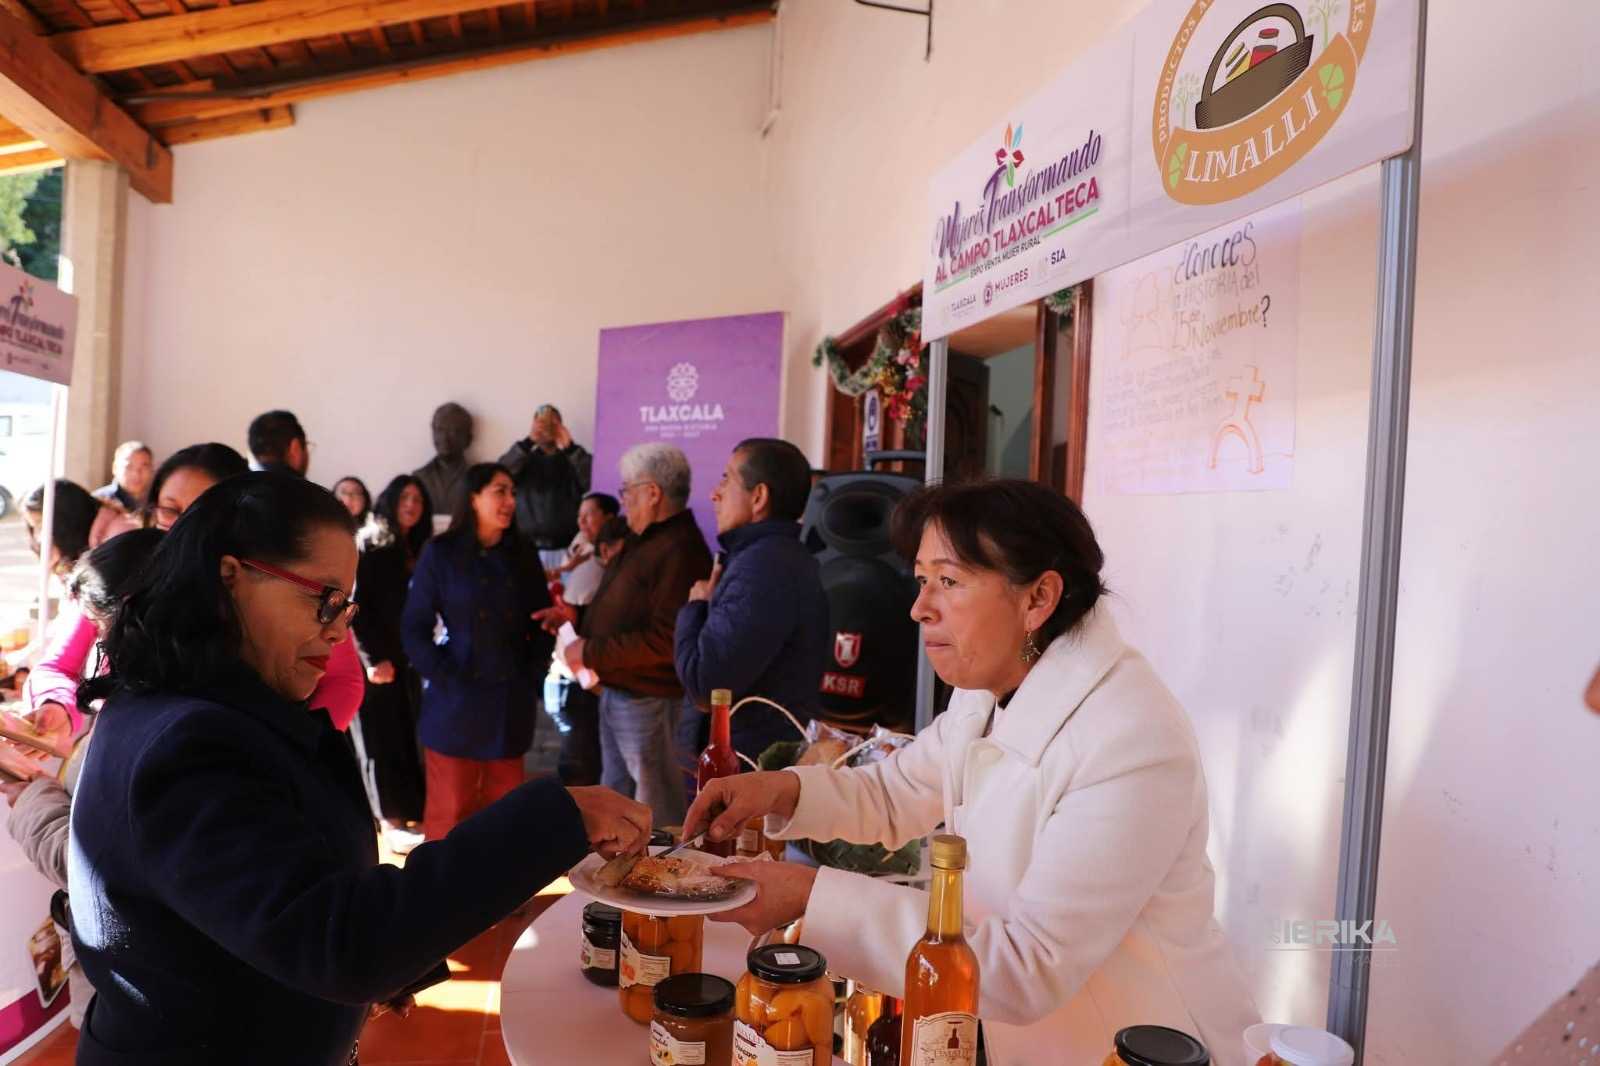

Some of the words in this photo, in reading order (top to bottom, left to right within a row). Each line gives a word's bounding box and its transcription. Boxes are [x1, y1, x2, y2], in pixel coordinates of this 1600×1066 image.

[1159, 19, 1196, 143] PRODUCTOS
[983, 129, 1102, 234] Transformando
[1184, 87, 1320, 183] LIMALLI
[934, 261, 948, 285] AL
[949, 237, 991, 275] CAMPO
[993, 175, 1099, 252] TLAXCALTECA
[994, 267, 1029, 292] MUJERES
[1050, 247, 1067, 265] SIA
[639, 403, 725, 423] TLAXCALA
[822, 673, 861, 695] KSR
